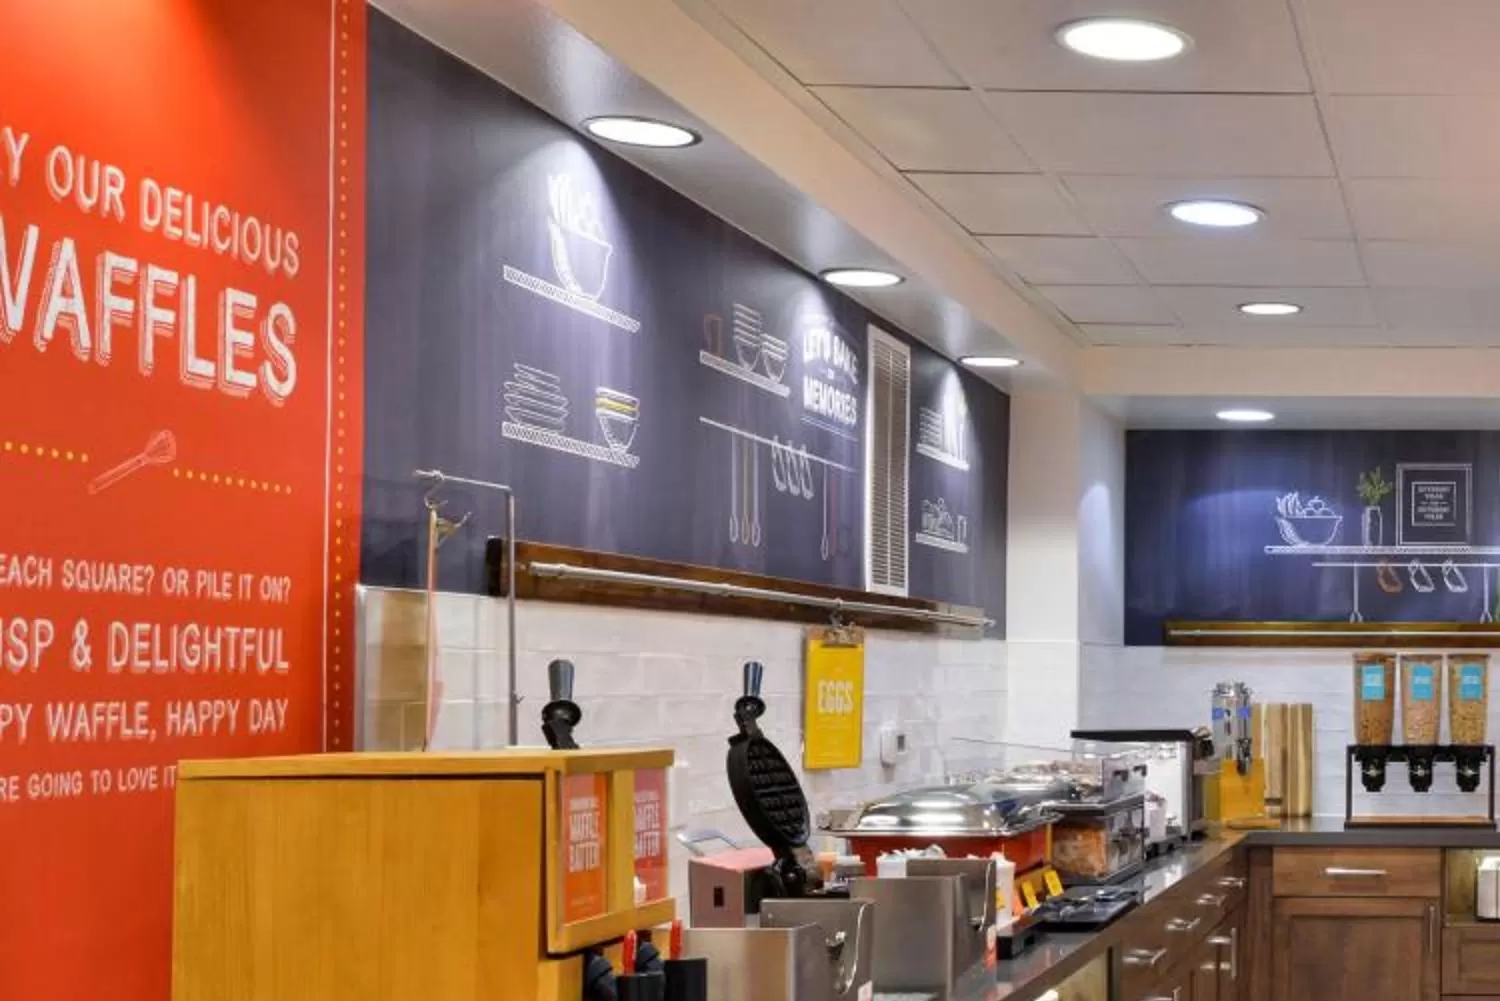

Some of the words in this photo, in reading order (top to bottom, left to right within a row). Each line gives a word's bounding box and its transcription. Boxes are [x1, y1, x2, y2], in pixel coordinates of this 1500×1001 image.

[47, 145, 125, 222] OUR
[140, 177, 299, 277] DELICIOUS
[61, 559, 155, 594] SQUARE?
[162, 566, 189, 597] OR
[195, 569, 233, 600] PILE
[239, 573, 254, 600] IT
[260, 575, 291, 604] ON?
[70, 617, 92, 672] &
[108, 620, 289, 673] DELIGHTFUL
[46, 701, 157, 742] WAFFLE,
[166, 699, 240, 737] HAPPY
[249, 699, 289, 735] DAY
[27, 770, 83, 800] GOING
[91, 768, 112, 794] TO
[117, 766, 159, 792] LOVE
